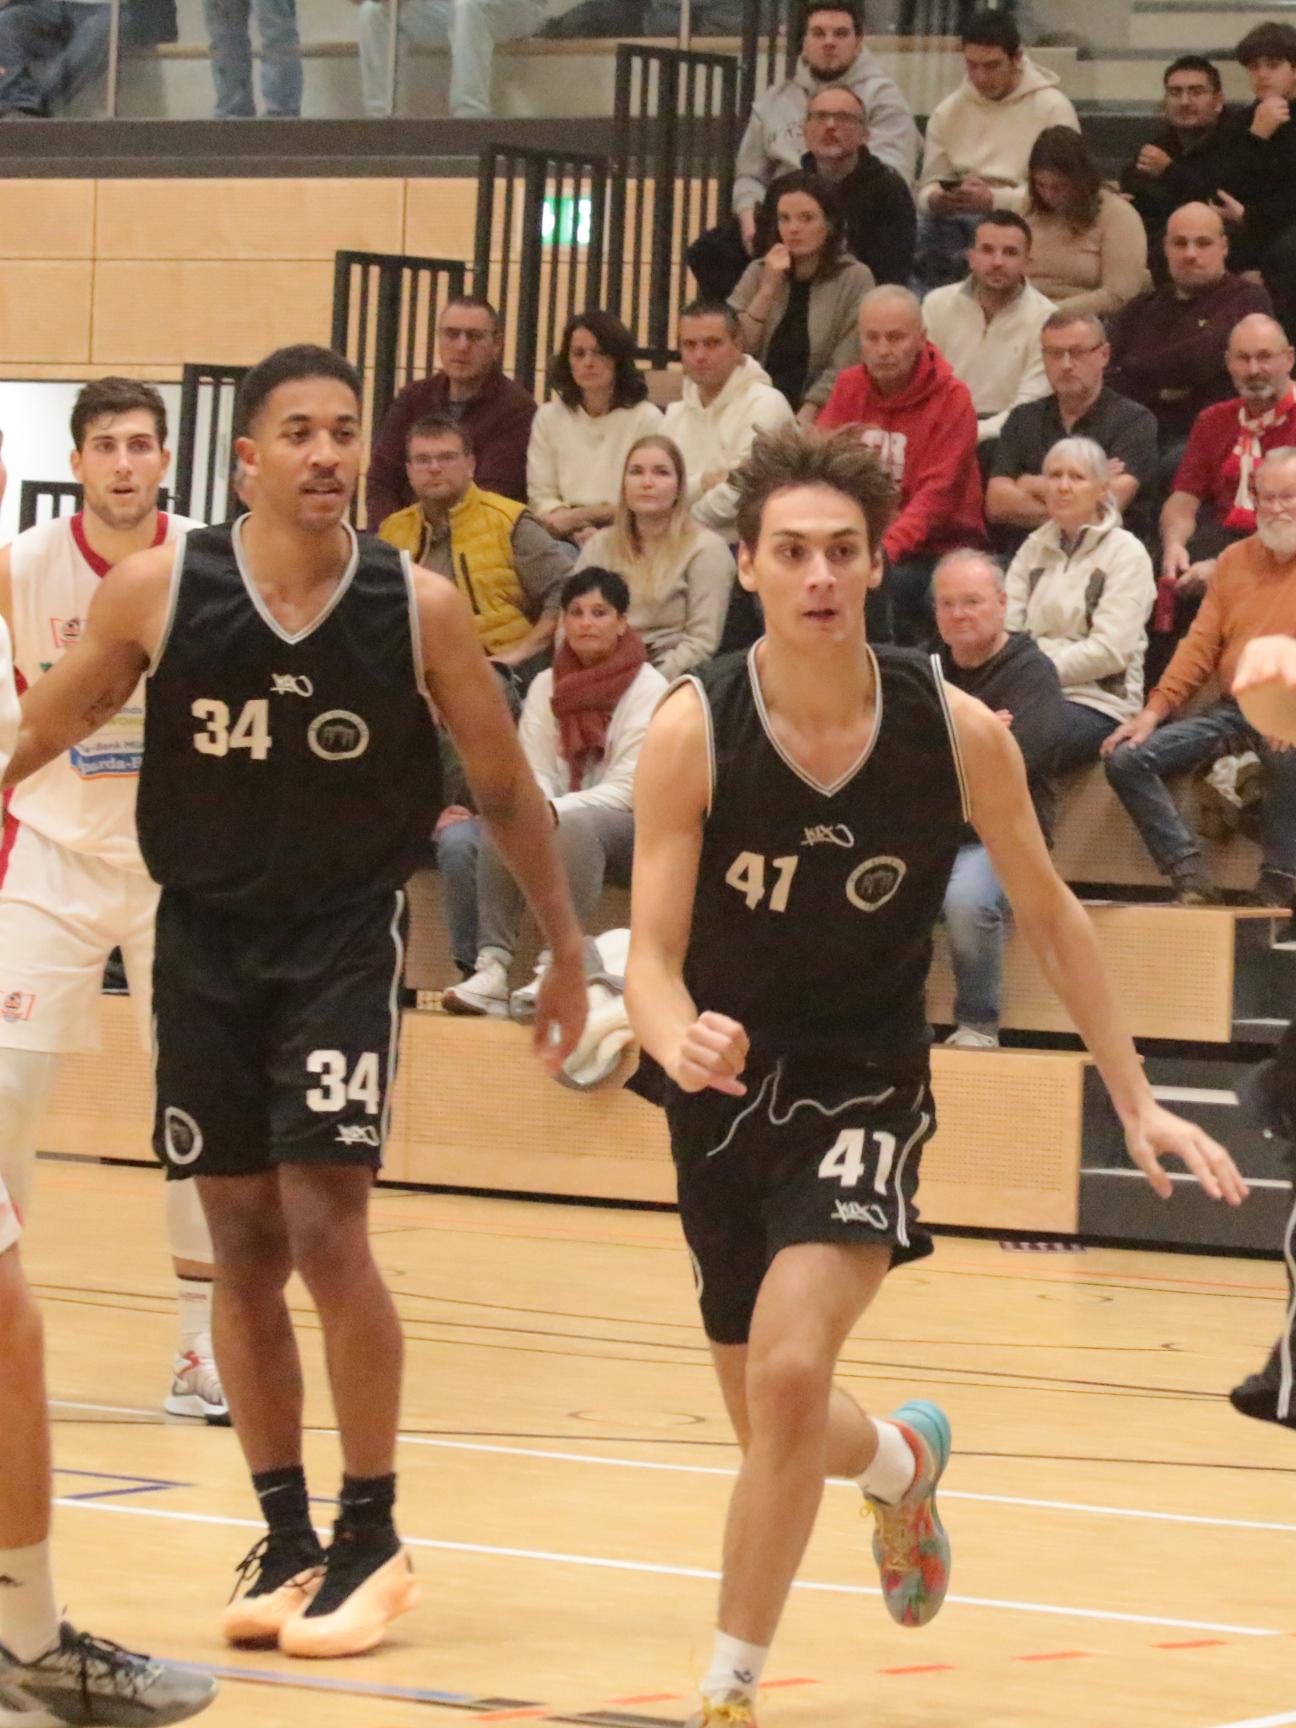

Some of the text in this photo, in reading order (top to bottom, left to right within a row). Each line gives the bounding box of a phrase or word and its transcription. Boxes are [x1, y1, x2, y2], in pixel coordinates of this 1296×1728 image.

[191, 699, 273, 760] 34
[725, 851, 799, 913] 41
[306, 1049, 380, 1114] 34
[818, 1128, 896, 1196] 41
